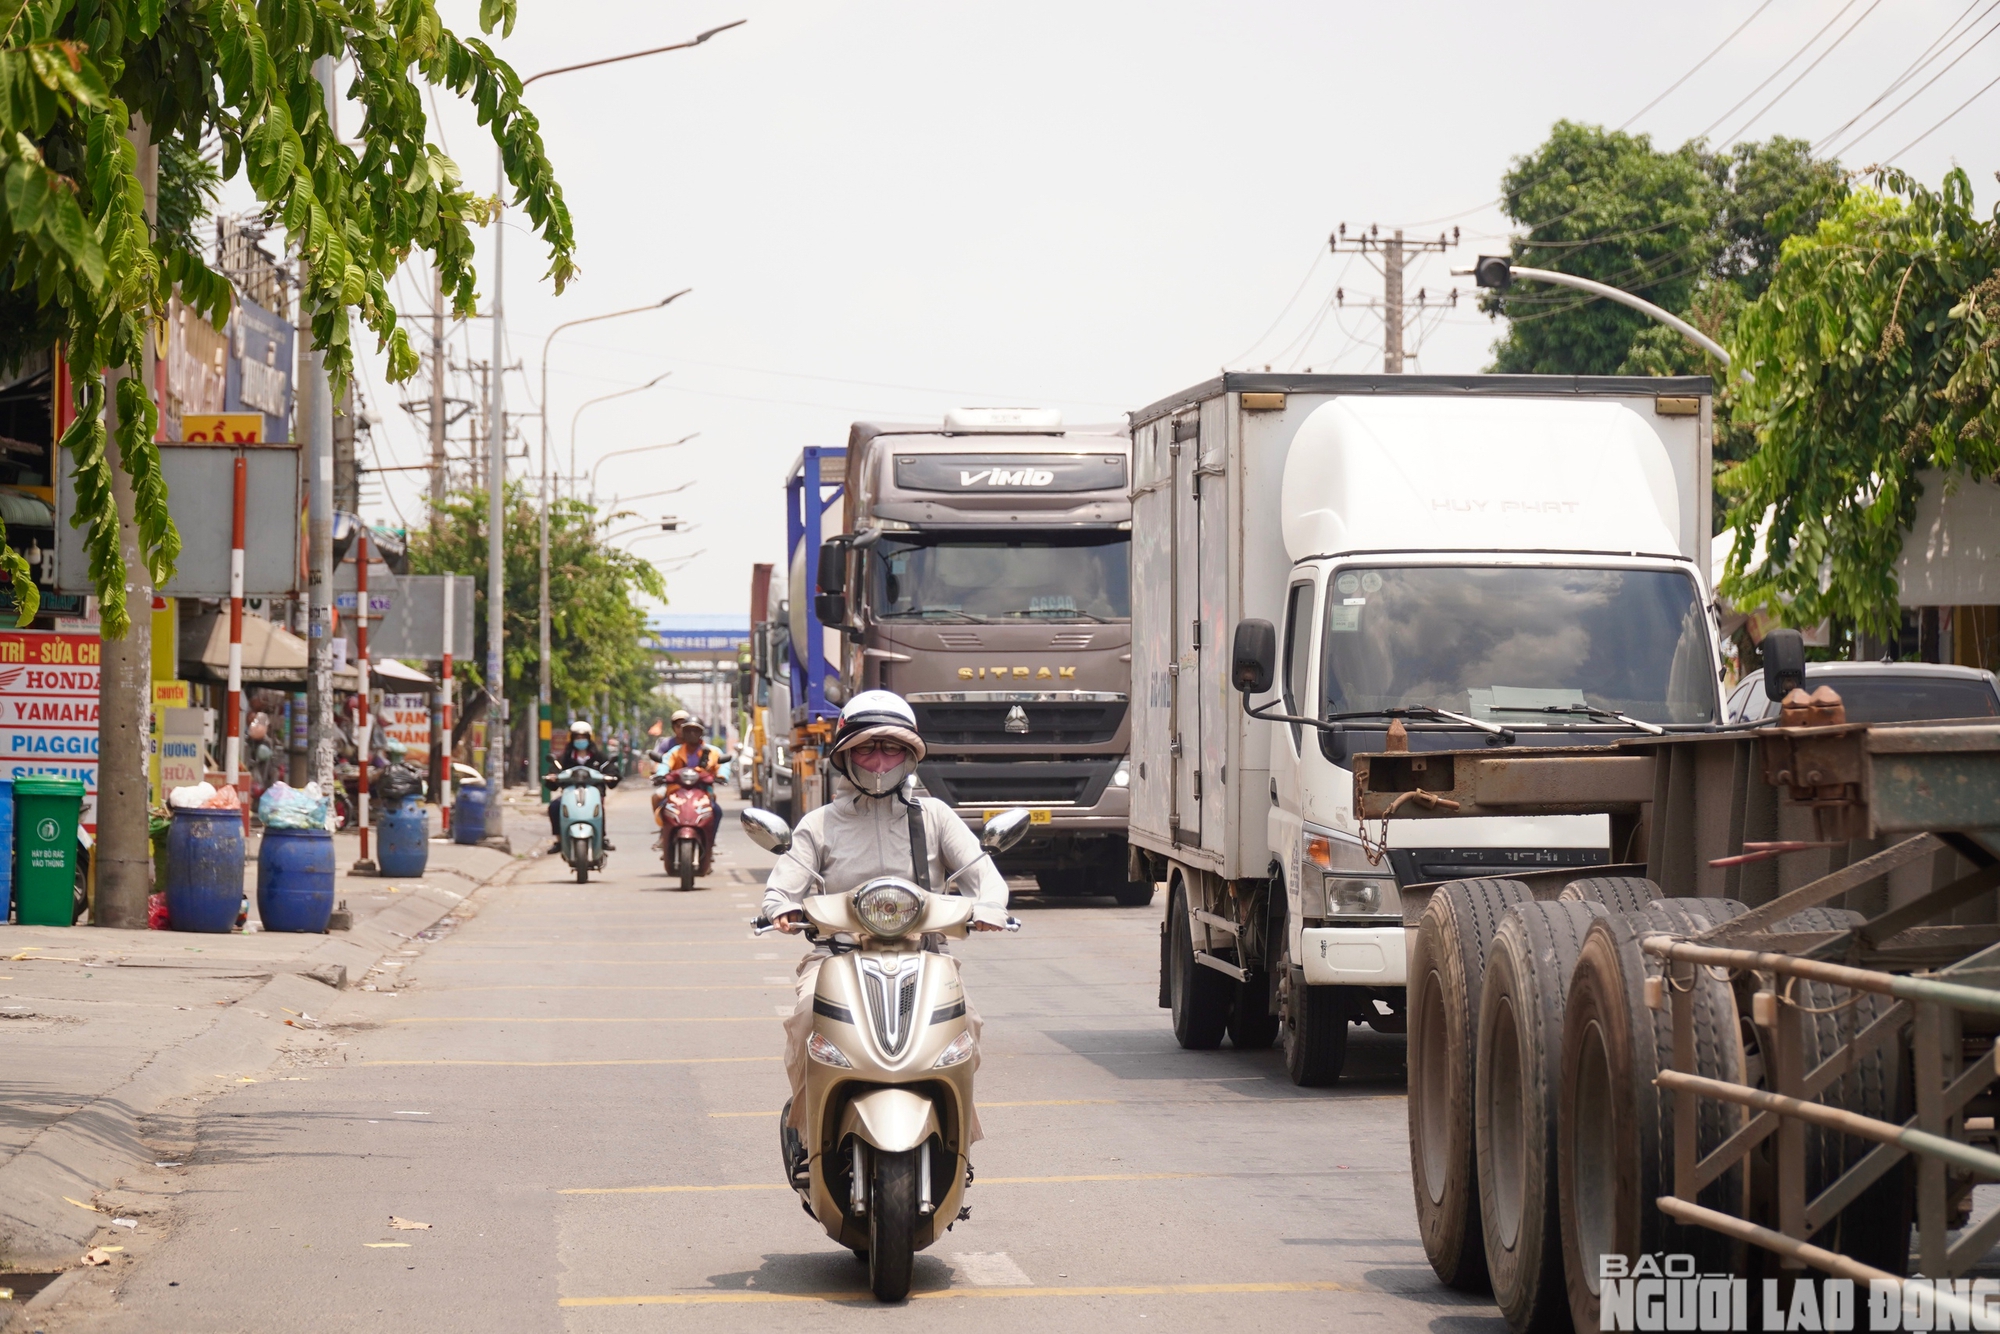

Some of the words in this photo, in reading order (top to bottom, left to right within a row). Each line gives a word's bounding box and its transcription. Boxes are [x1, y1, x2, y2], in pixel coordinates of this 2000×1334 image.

[1430, 498, 1489, 512] HUY
[41, 636, 73, 664] SỬA
[957, 666, 1077, 680] SITRAK
[14, 702, 99, 722] YAMAHA
